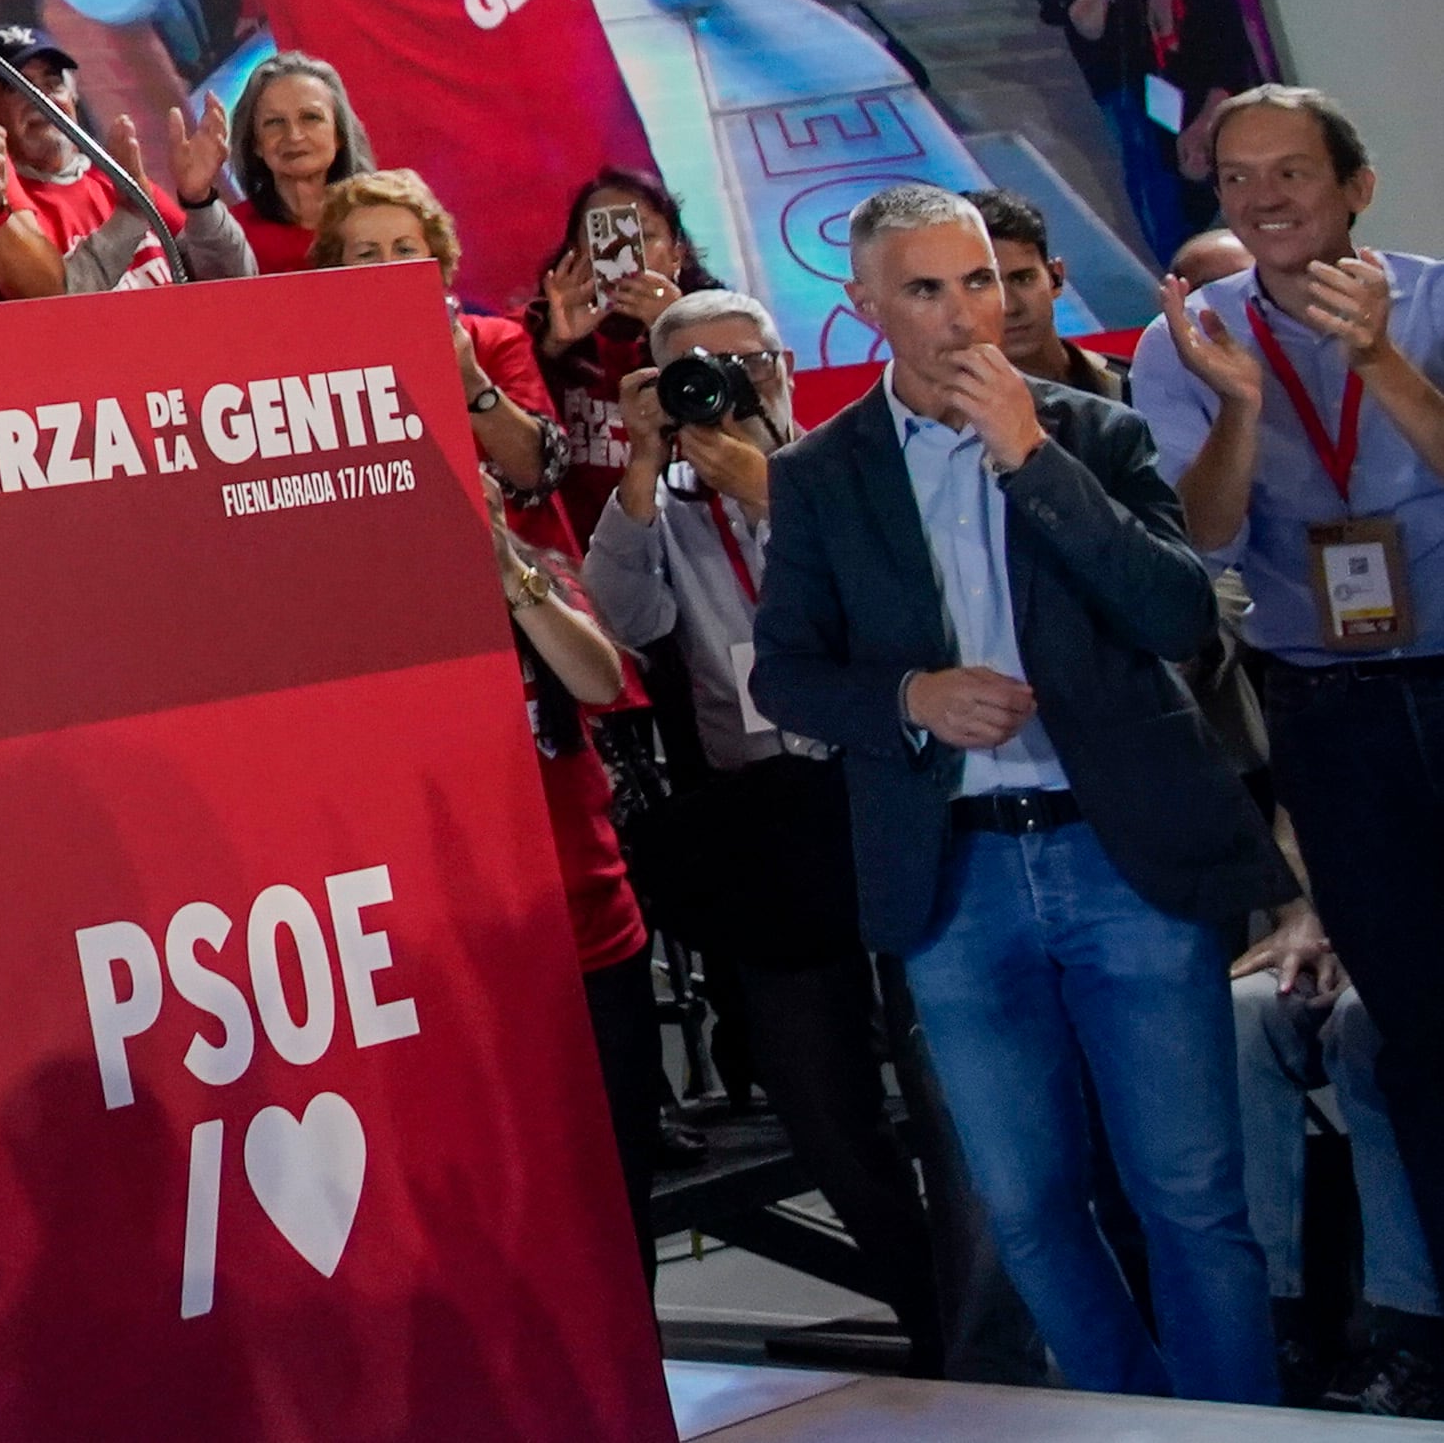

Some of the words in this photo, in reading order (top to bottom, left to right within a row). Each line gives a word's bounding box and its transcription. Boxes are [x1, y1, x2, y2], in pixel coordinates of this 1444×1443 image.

[146, 389, 188, 428] DE
[201, 365, 423, 464] GENTE.
[154, 434, 198, 474] LA
[222, 471, 336, 517] FUENLABRADA
[337, 459, 415, 499] 17/10/26
[75, 864, 420, 1110] PSOE
